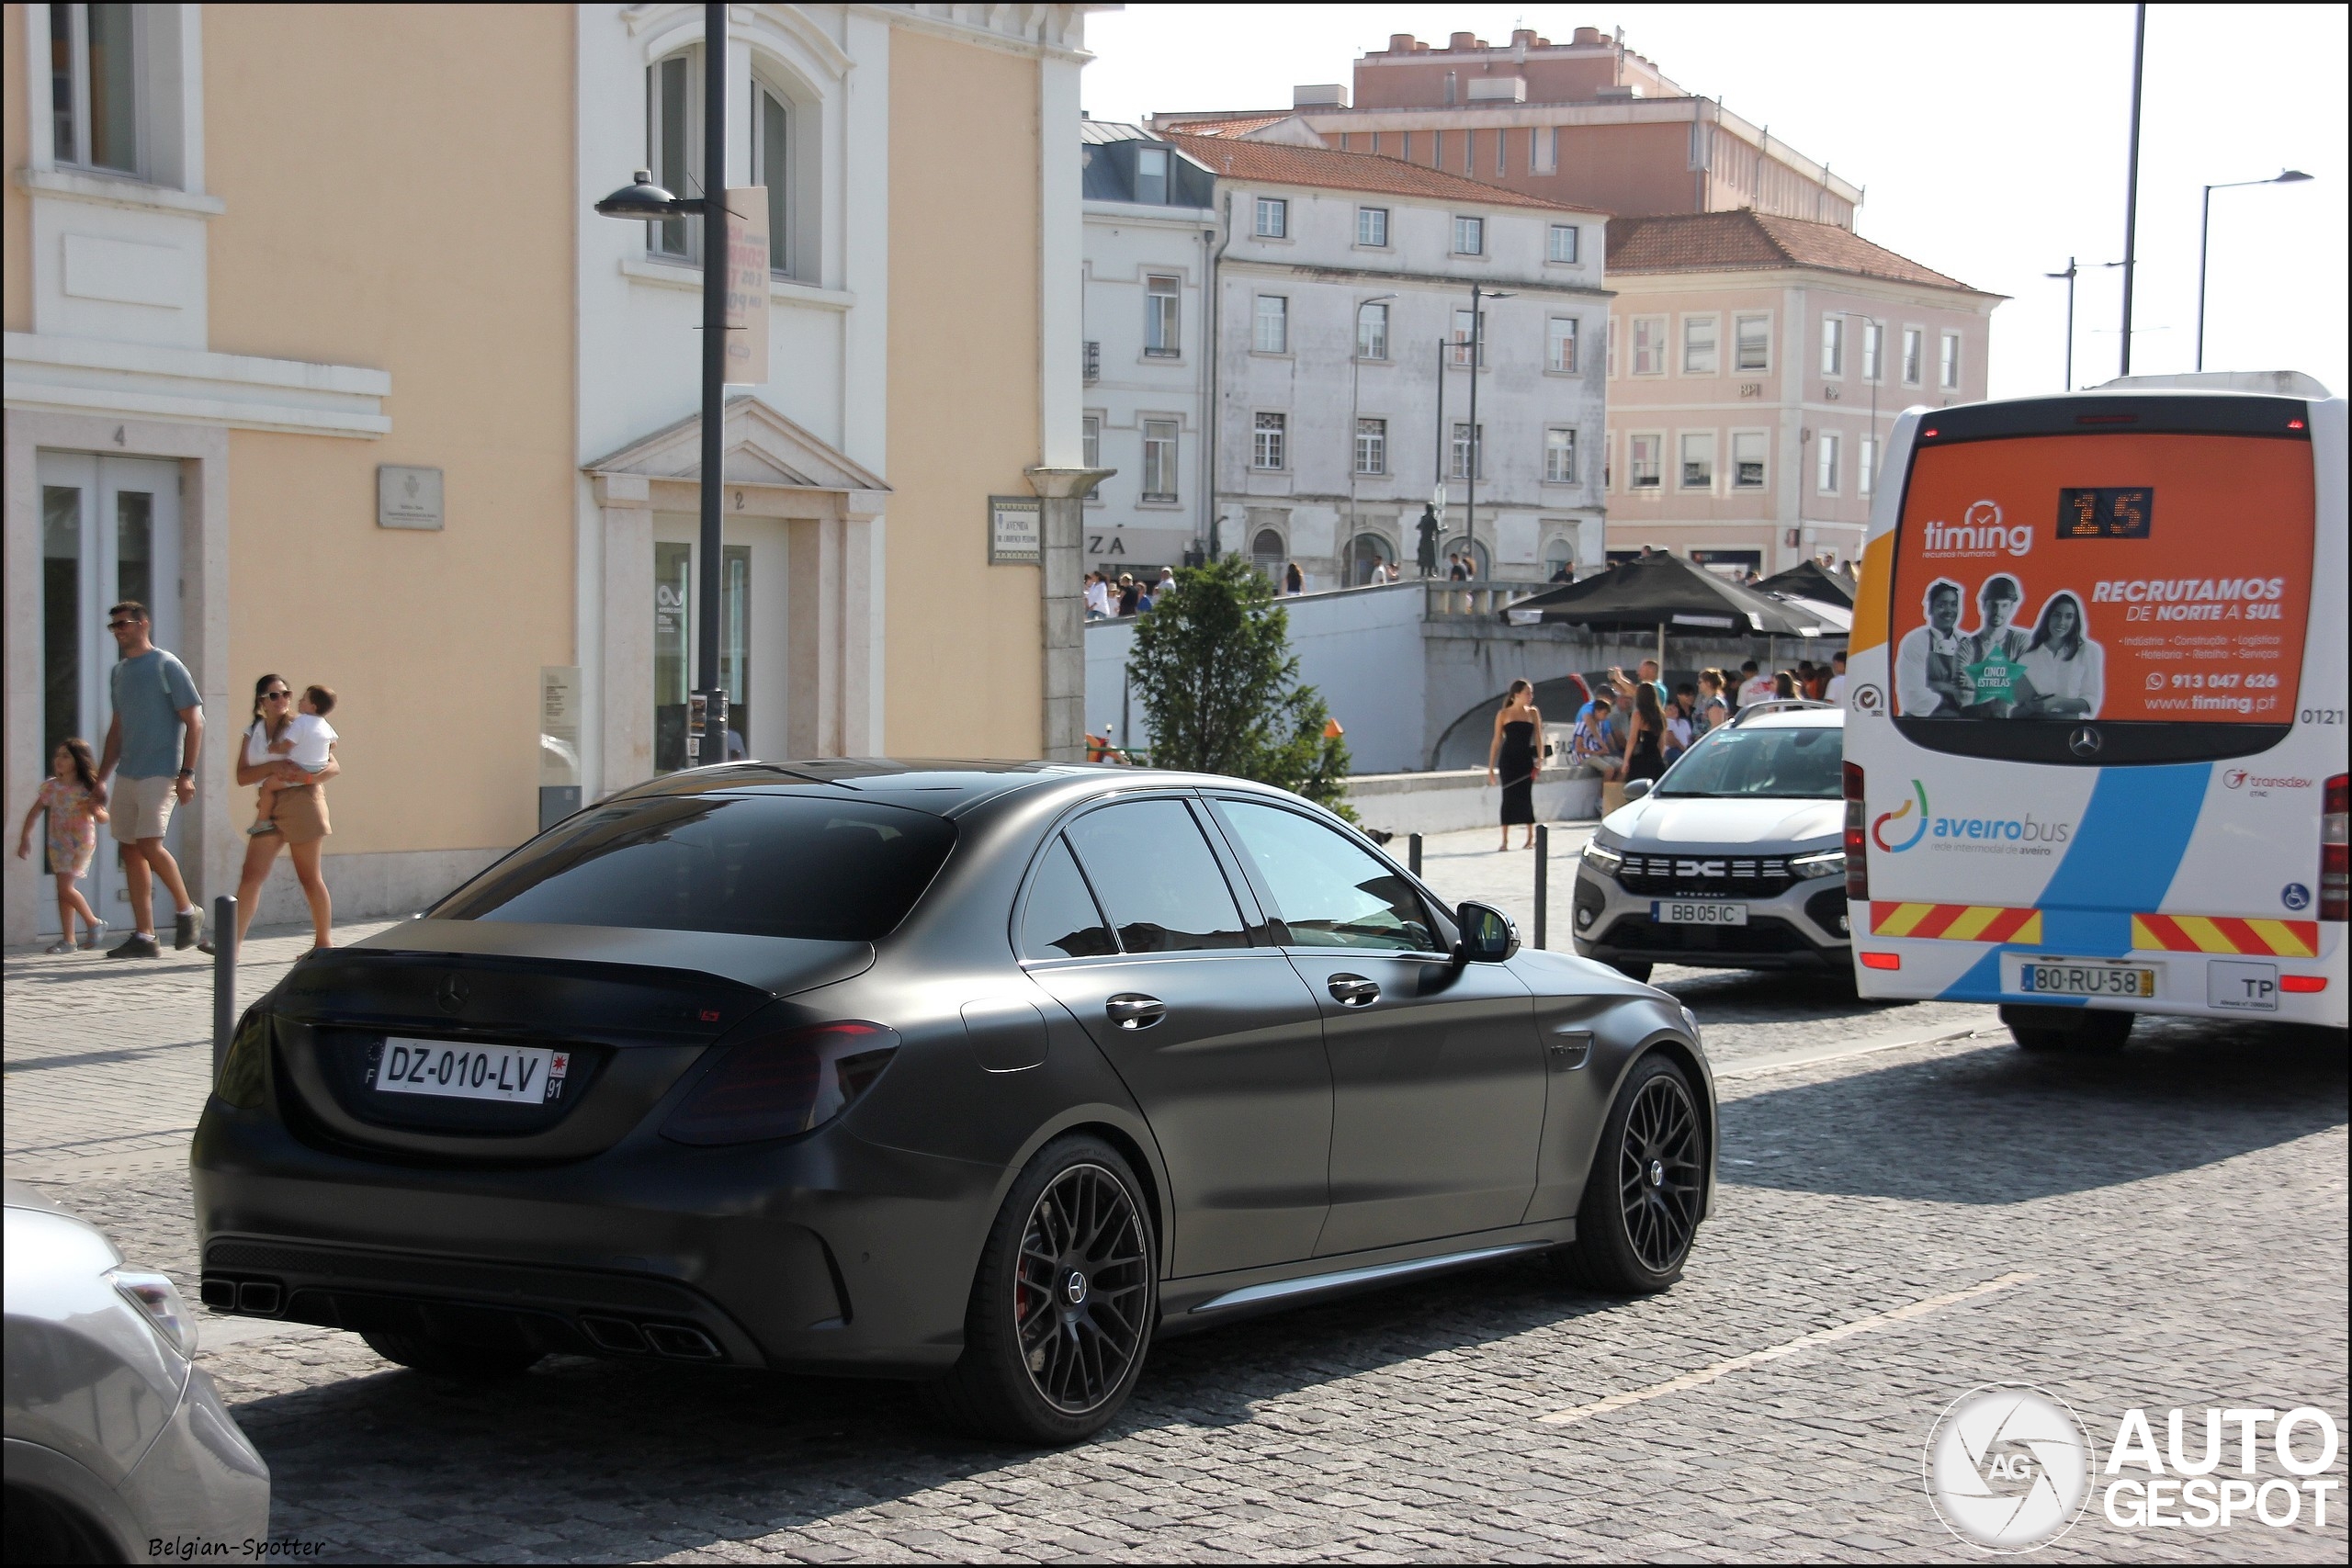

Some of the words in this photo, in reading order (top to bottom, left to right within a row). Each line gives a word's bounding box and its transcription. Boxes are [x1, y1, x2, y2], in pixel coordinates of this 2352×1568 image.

[113, 424, 127, 447] 4
[735, 491, 745, 511] 2
[2072, 493, 2143, 535] 15
[1923, 521, 2033, 557] timing
[2091, 578, 2283, 603] RECRUTAMOS
[2125, 605, 2152, 622] DE
[2155, 604, 2222, 621] NORTE
[2224, 604, 2240, 620] A
[2245, 604, 2281, 620] SUL
[1984, 667, 2006, 677] CINCO
[2171, 674, 2203, 688] 913
[2208, 673, 2240, 688] 047
[2244, 673, 2277, 688] 626
[1977, 678, 2010, 687] ESTRELAS
[2144, 694, 2277, 714] www.timing.pt
[2300, 709, 2346, 725] 0121
[2249, 776, 2312, 788] transdev
[1932, 813, 2068, 842] aveirobus
[1930, 841, 1952, 852] rede
[1953, 843, 2004, 854] intermodal
[2006, 844, 2018, 854] de
[2019, 845, 2052, 856] aveiro
[2241, 979, 2274, 998] TP
[388, 1046, 539, 1092] DZ-010-LV
[546, 1078, 563, 1099] 91
